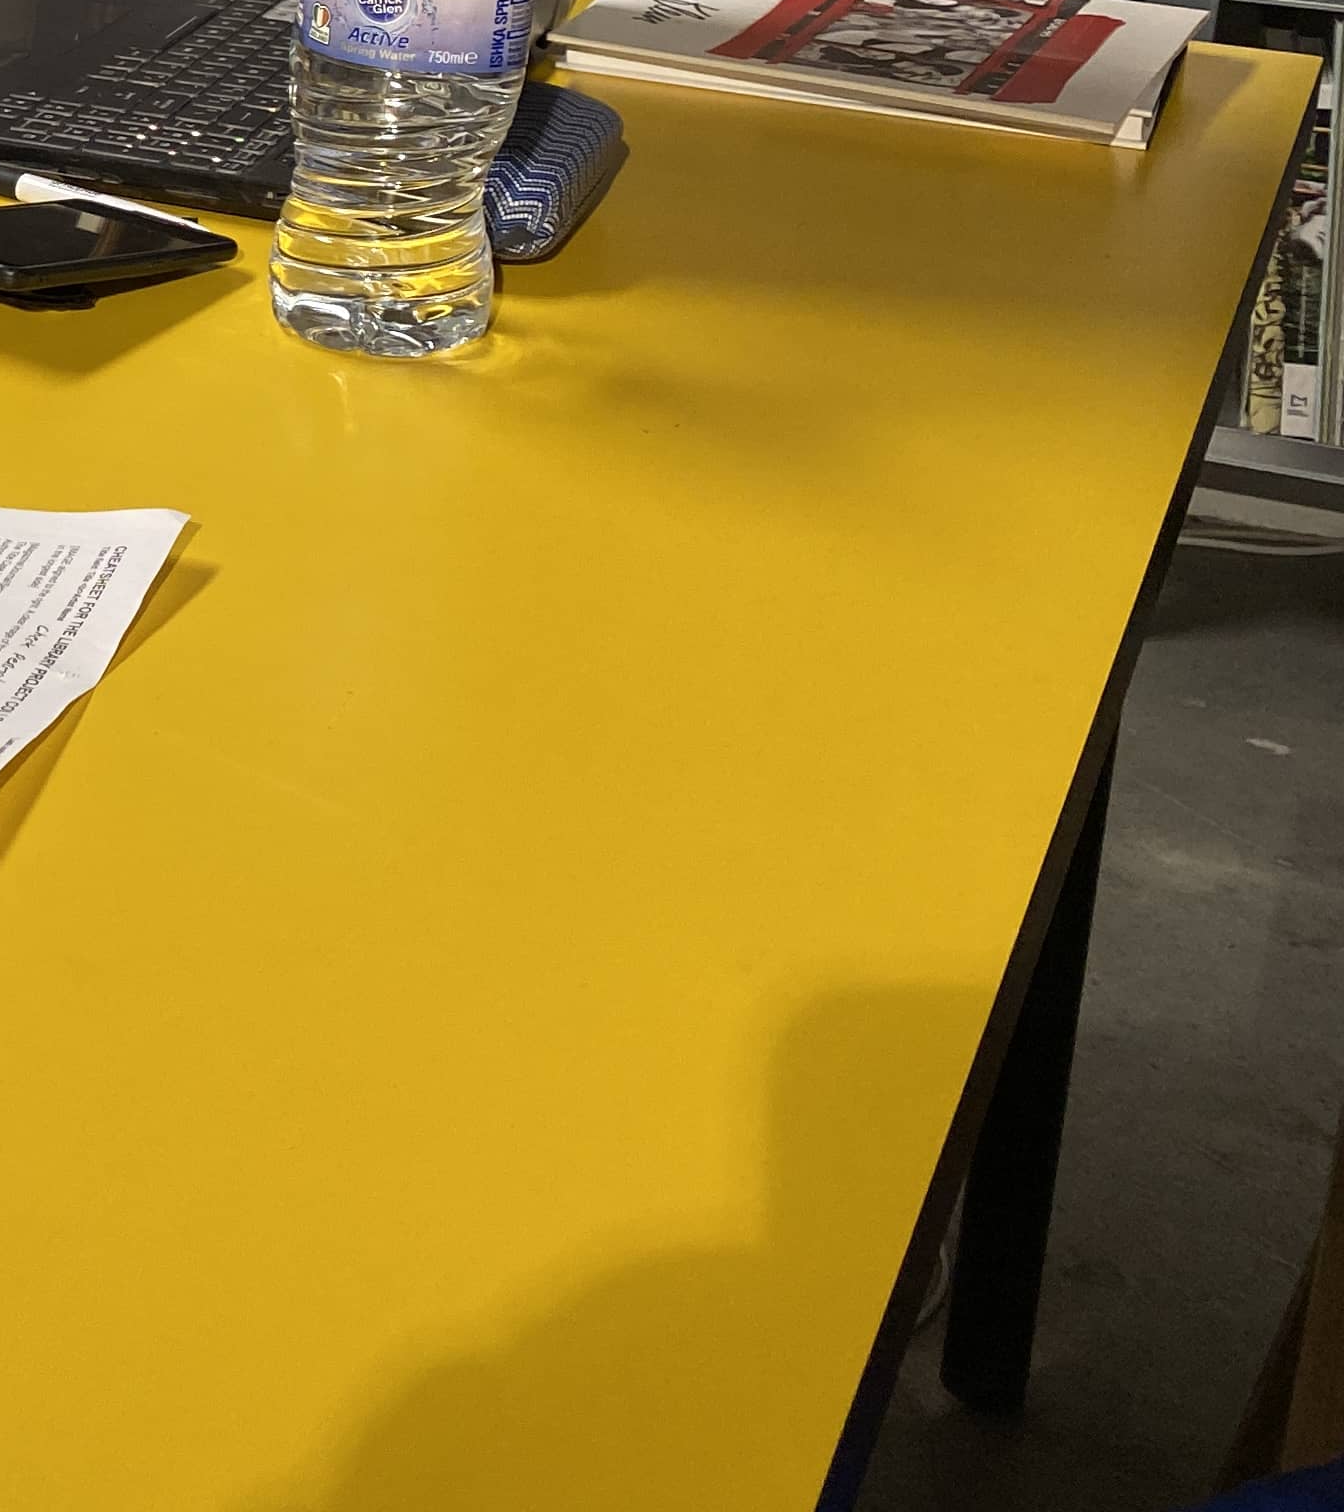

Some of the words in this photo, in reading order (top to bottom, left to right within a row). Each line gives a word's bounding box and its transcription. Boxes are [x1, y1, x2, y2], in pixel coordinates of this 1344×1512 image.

[373, 3, 403, 14] Glen
[347, 26, 410, 49] Active
[489, 26, 505, 69] ISHKA
[379, 48, 416, 62] Water
[85, 544, 128, 600] CHEATSHEET
[73, 601, 95, 619] FOR
[60, 620, 84, 637] THE
[35, 636, 73, 669] LIBRARY
[9, 667, 48, 701] PROJECT
